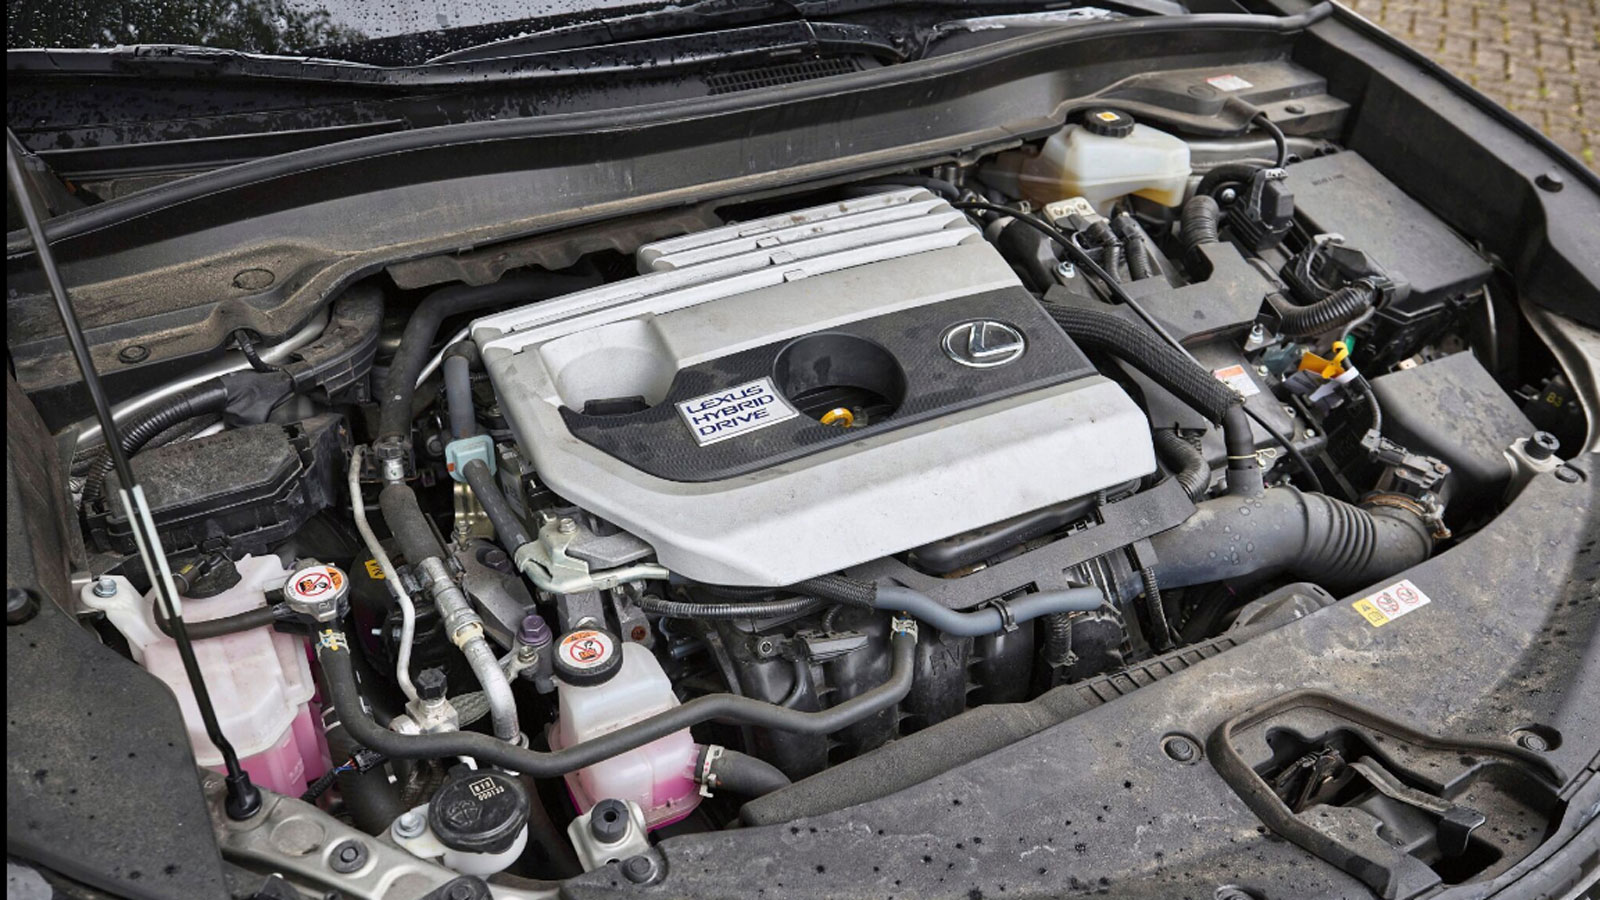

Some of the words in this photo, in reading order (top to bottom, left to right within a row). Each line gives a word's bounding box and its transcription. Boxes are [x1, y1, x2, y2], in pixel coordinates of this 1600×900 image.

[686, 384, 764, 414] LEXUS
[692, 394, 775, 425] HYBRID
[699, 407, 770, 436] DRIVE
